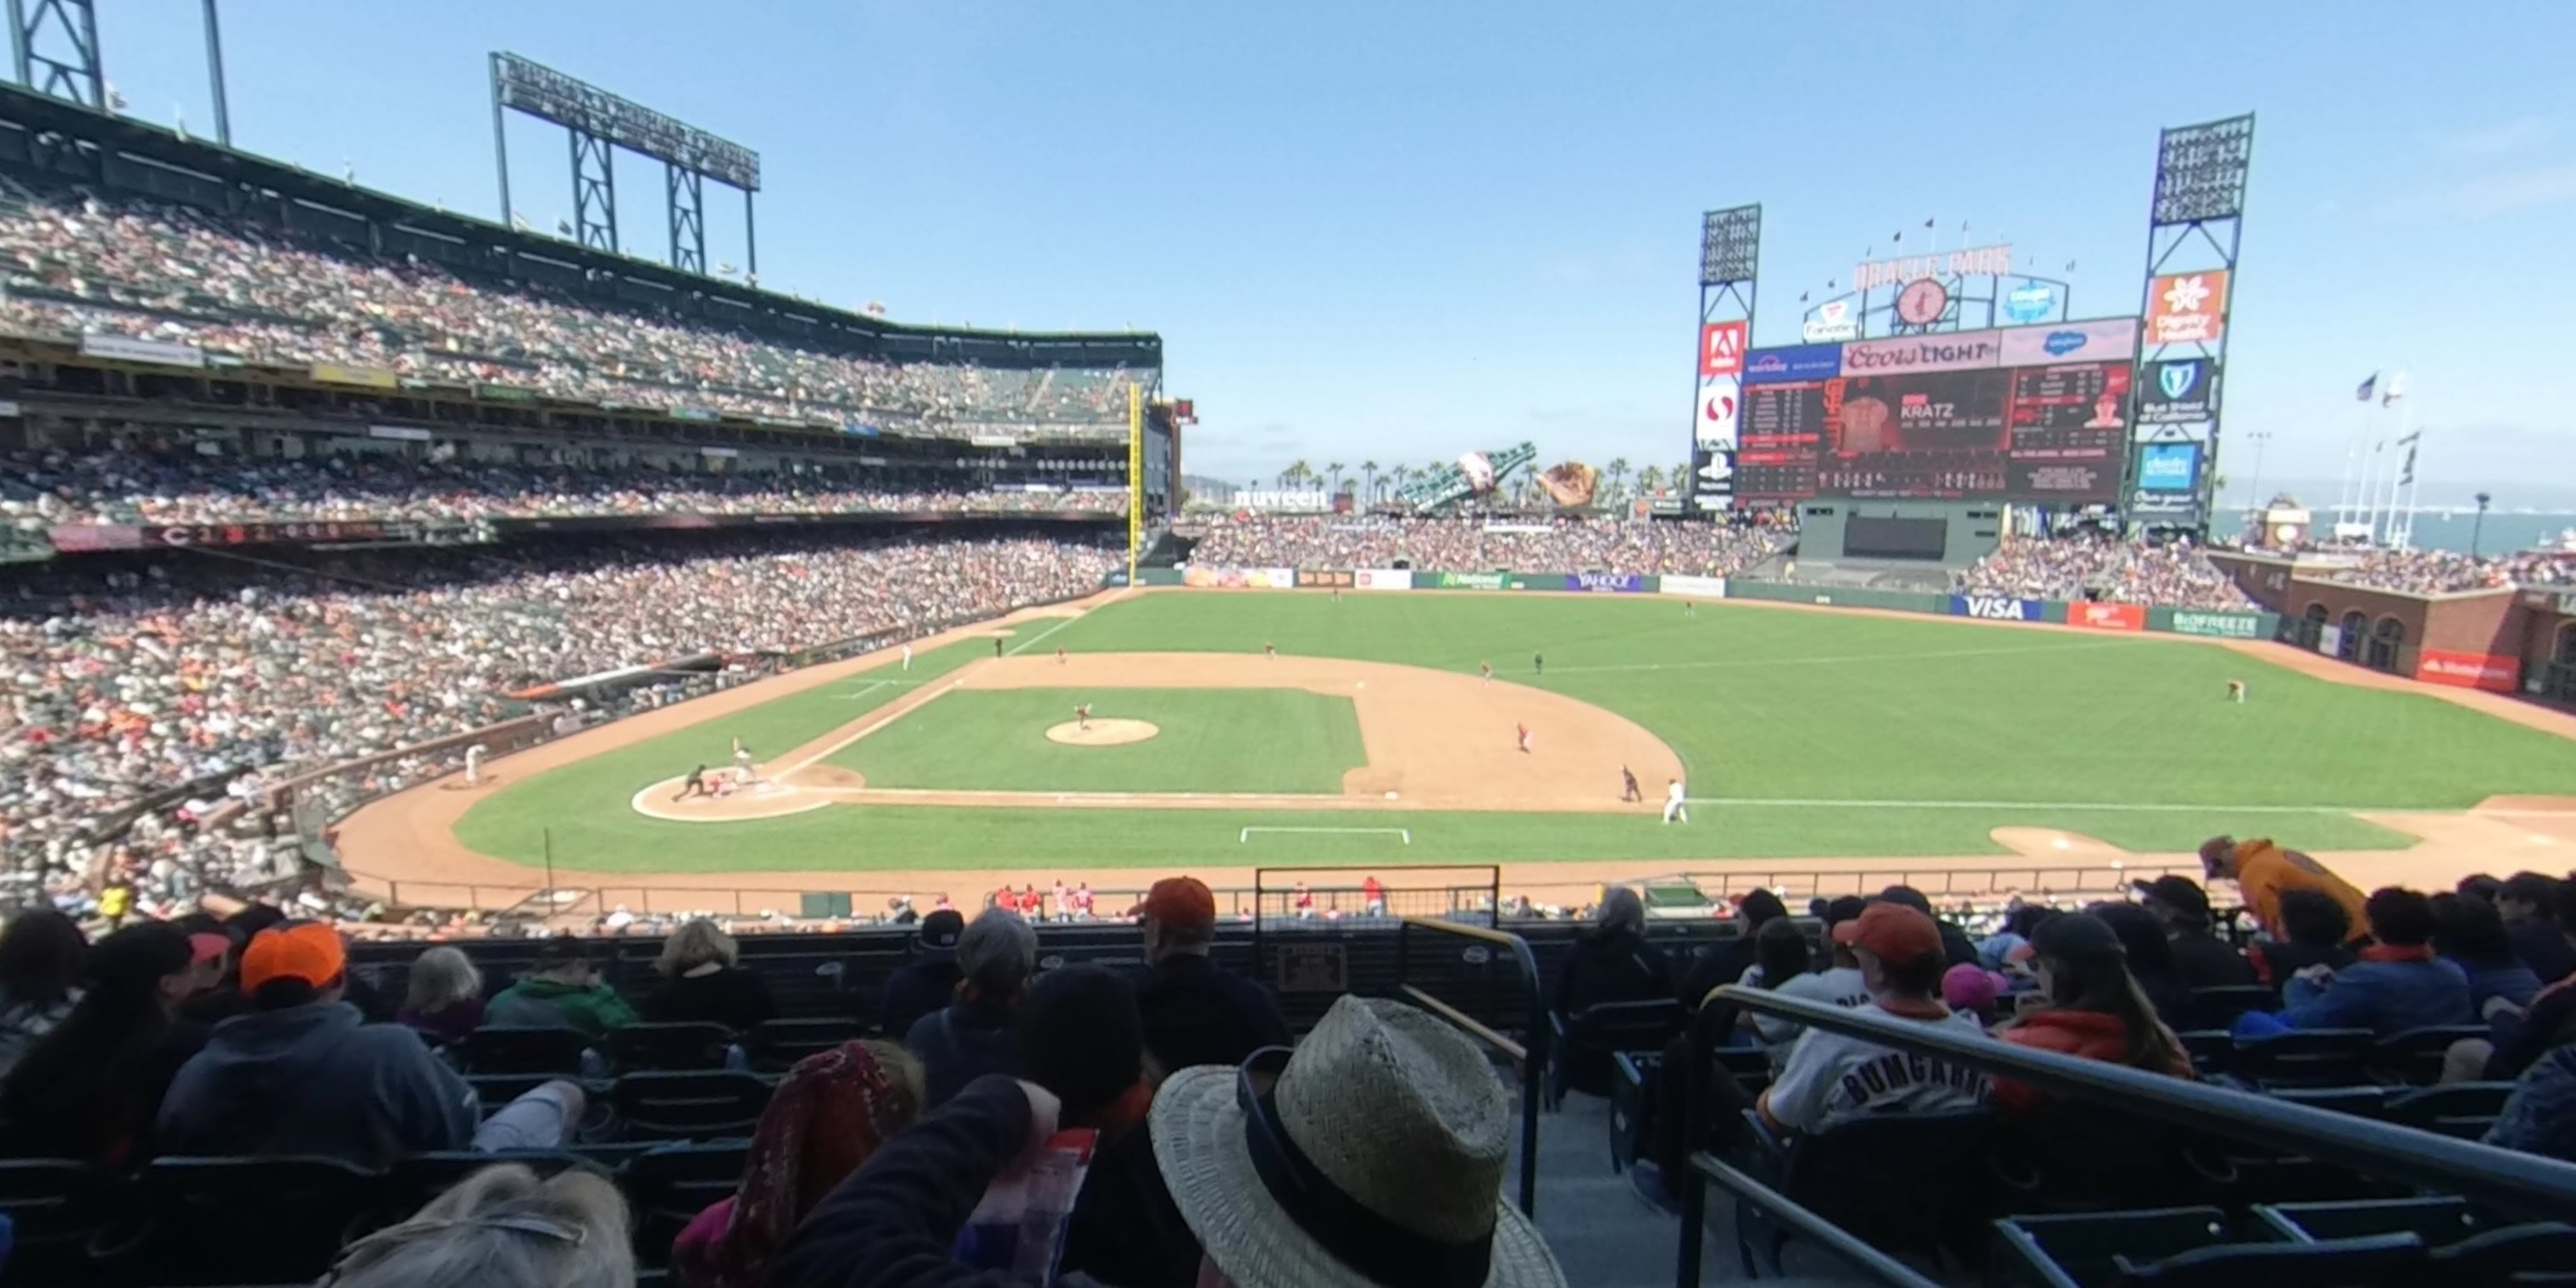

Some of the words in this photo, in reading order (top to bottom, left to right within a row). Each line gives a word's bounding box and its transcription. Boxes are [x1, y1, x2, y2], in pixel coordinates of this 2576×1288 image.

[1854, 253, 1940, 291] ORACLE
[1948, 244, 2012, 277] PARK
[1848, 343, 1918, 369] Coors
[1920, 341, 1988, 364] LIGHT
[1901, 402, 1954, 419] KRATZ
[1235, 490, 1328, 507] nuveen
[1963, 595, 2024, 619] VISA
